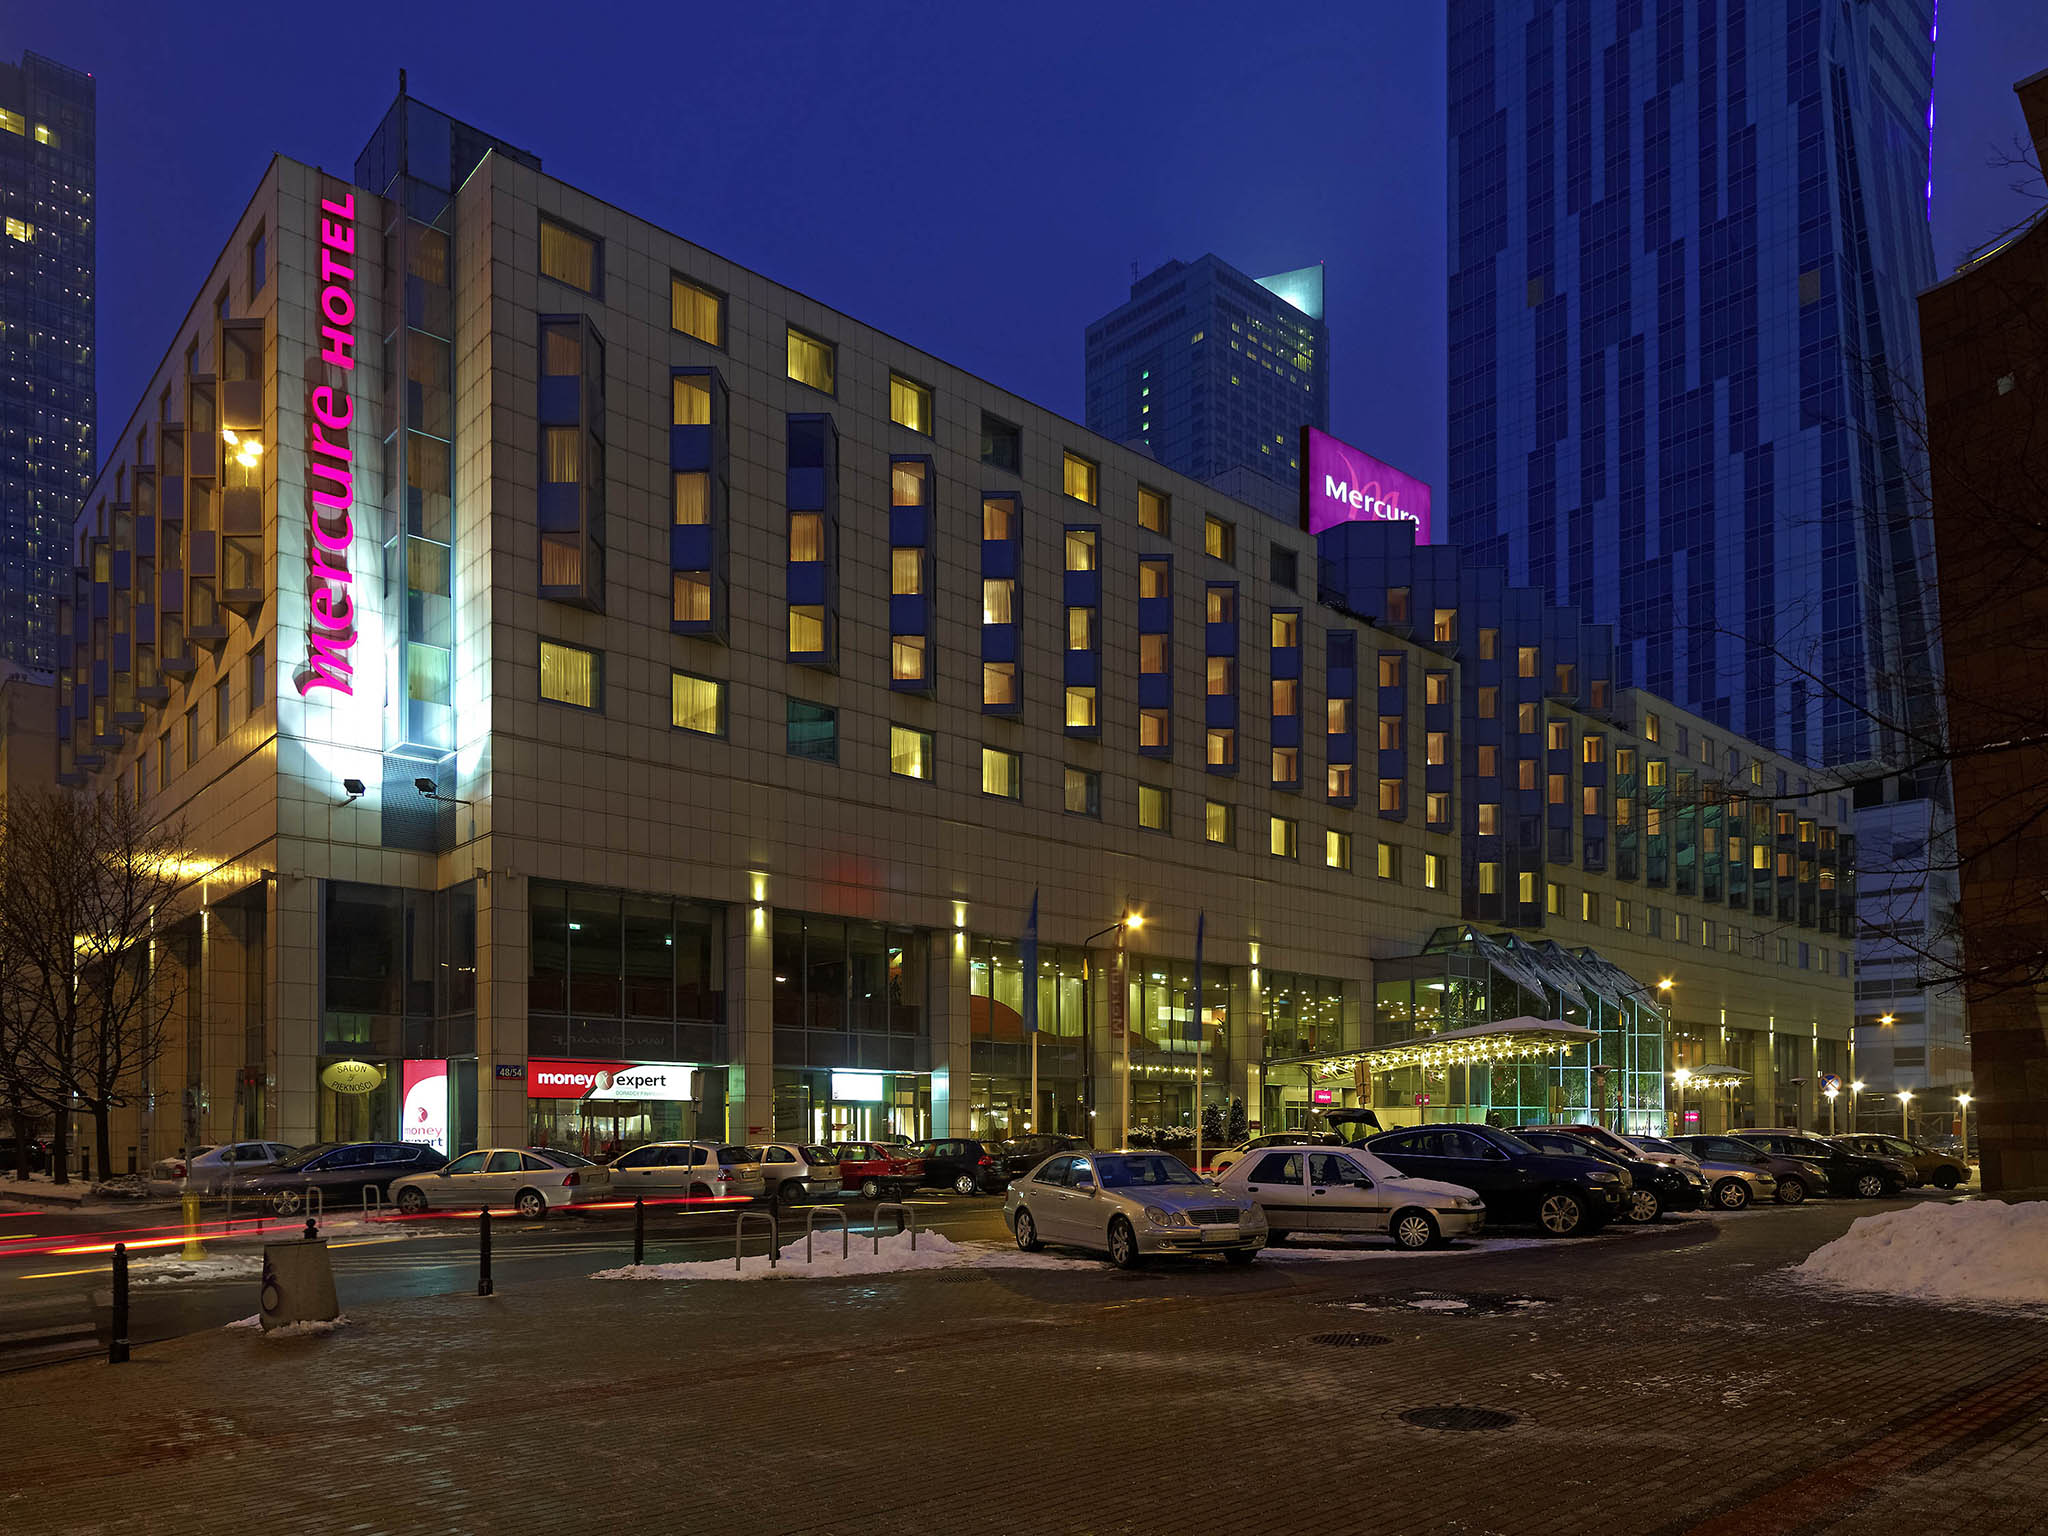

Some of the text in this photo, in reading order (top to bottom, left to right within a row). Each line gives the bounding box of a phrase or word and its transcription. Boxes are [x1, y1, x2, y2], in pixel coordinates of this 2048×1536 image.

[321, 192, 355, 371] HOTEL
[336, 1064, 367, 1074] SALON
[499, 1067, 522, 1077] 48/54
[537, 1073, 666, 1089] money expert
[404, 1127, 443, 1138] money
